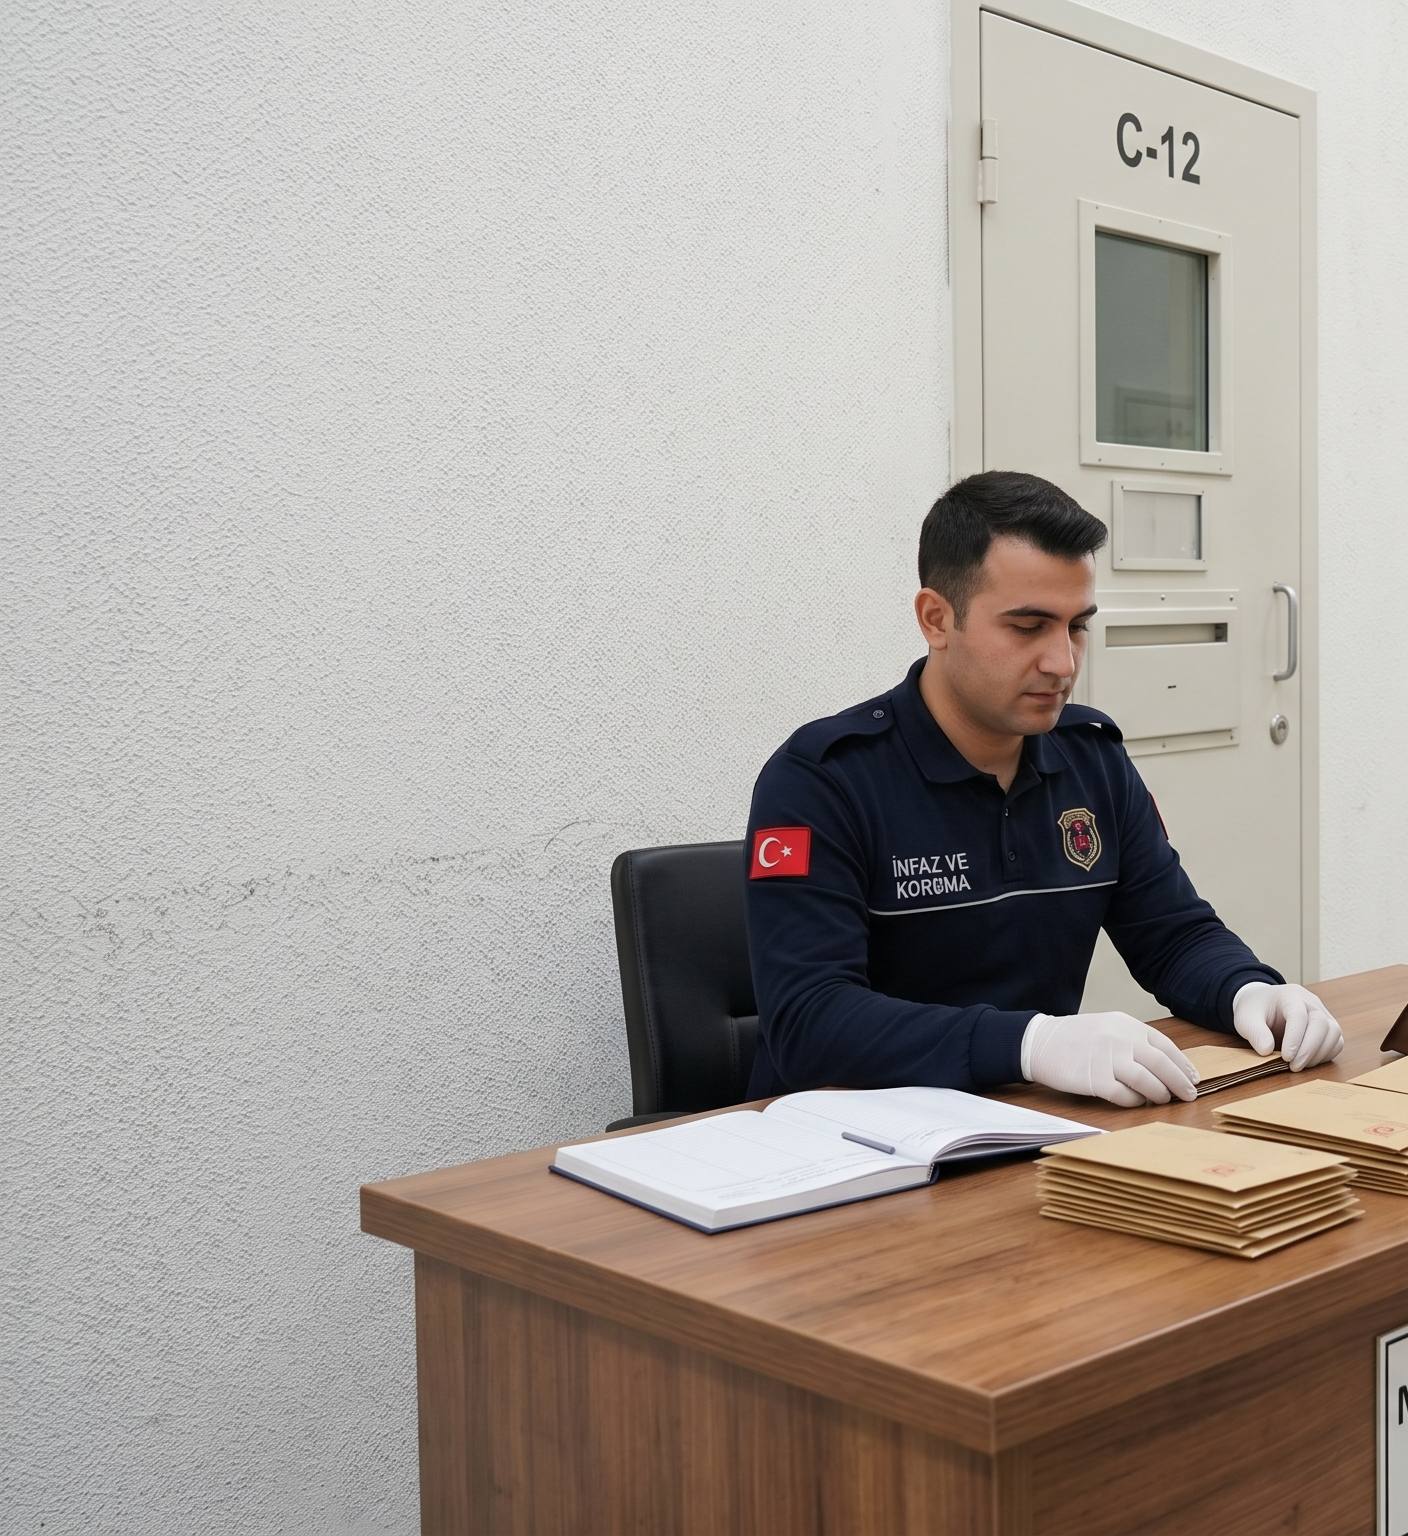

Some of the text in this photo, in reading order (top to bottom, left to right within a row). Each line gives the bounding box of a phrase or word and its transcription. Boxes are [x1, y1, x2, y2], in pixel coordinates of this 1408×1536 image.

[1116, 112, 1201, 185] C-12
[892, 852, 970, 878] İNFAZ VE
